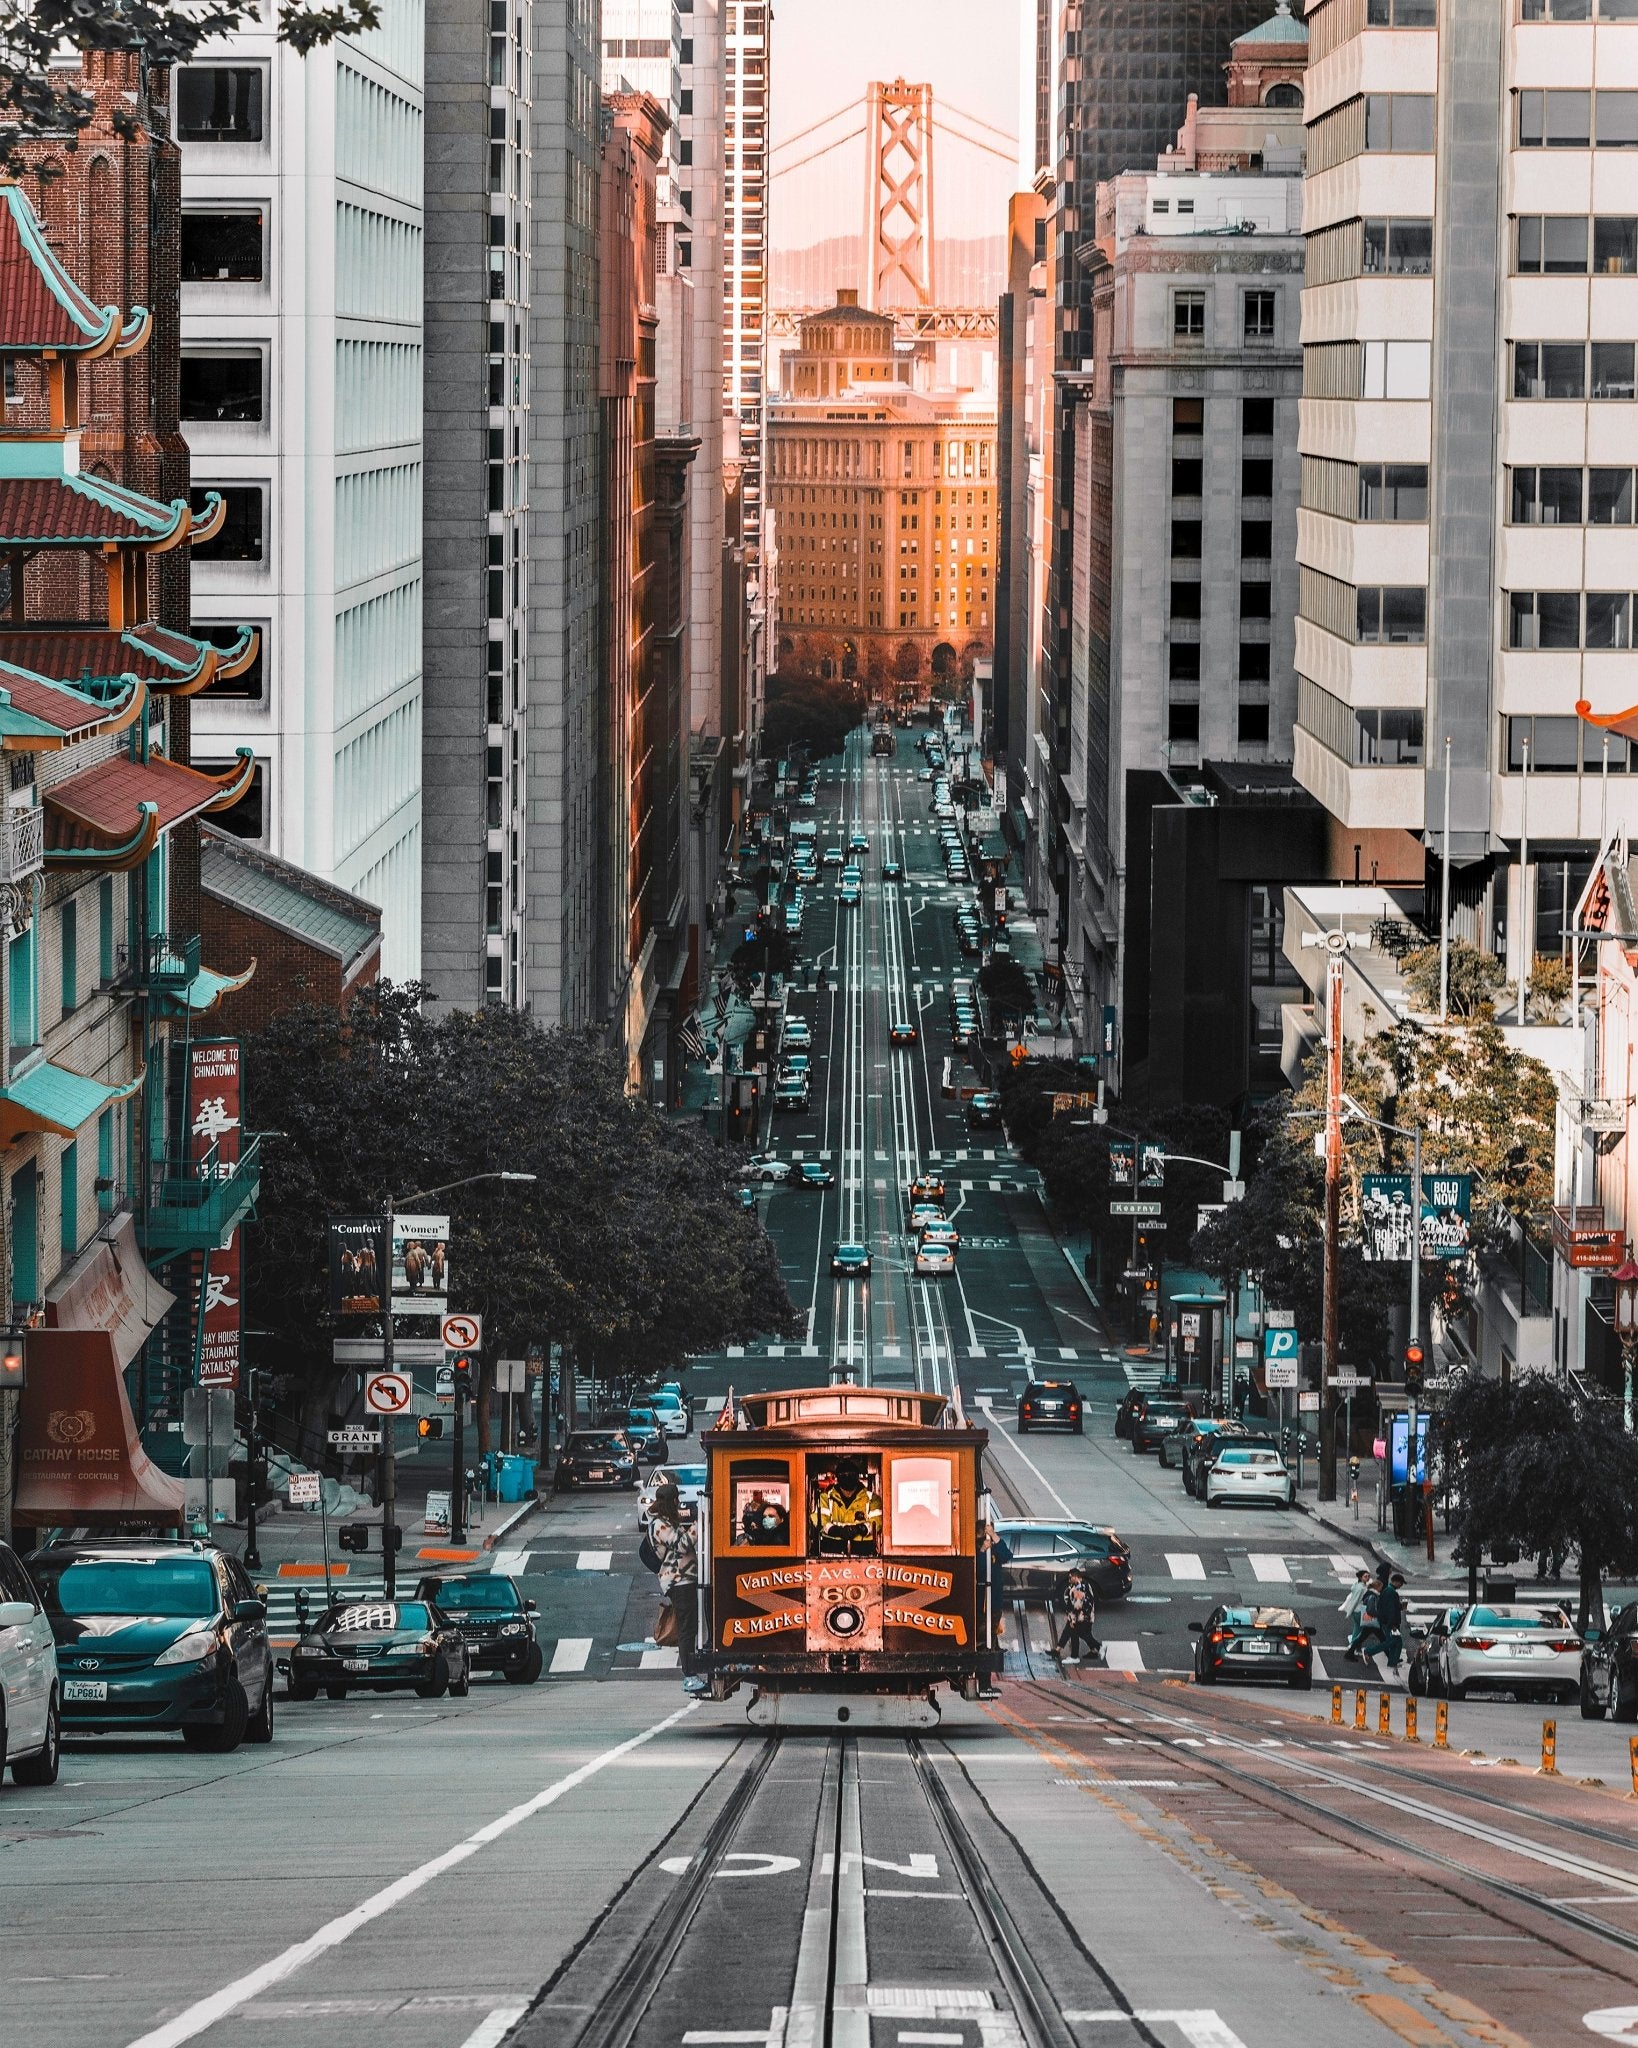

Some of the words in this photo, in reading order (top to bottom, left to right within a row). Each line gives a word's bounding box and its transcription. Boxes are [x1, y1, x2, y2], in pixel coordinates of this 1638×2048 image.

[192, 1050, 226, 1063] WELCOME
[229, 1048, 239, 1061] TO
[194, 1064, 236, 1078] CHINATOWN
[1433, 1181, 1459, 1194] BOLD
[1433, 1194, 1458, 1206] NOW
[1116, 1204, 1155, 1213] Kearny
[331, 1223, 381, 1234] “Comfort
[400, 1224, 445, 1234] Women”
[1375, 1228, 1399, 1241] BOLD
[217, 1330, 240, 1344] HOUSE
[1270, 1332, 1294, 1356] P
[331, 1432, 378, 1441] GRANT
[23, 1449, 72, 1461] CATHAY
[78, 1449, 120, 1461] HOUSE
[24, 1472, 71, 1480] RESTAURANT
[78, 1472, 119, 1480] COCKTAILS
[290, 1474, 299, 1483] NO
[741, 1575, 770, 1590] Van
[771, 1570, 813, 1585] Ness
[865, 1564, 949, 1588] California
[822, 1585, 866, 1604] 60
[733, 1619, 746, 1634] &
[749, 1610, 811, 1634] Market
[883, 1608, 955, 1630] Streets
